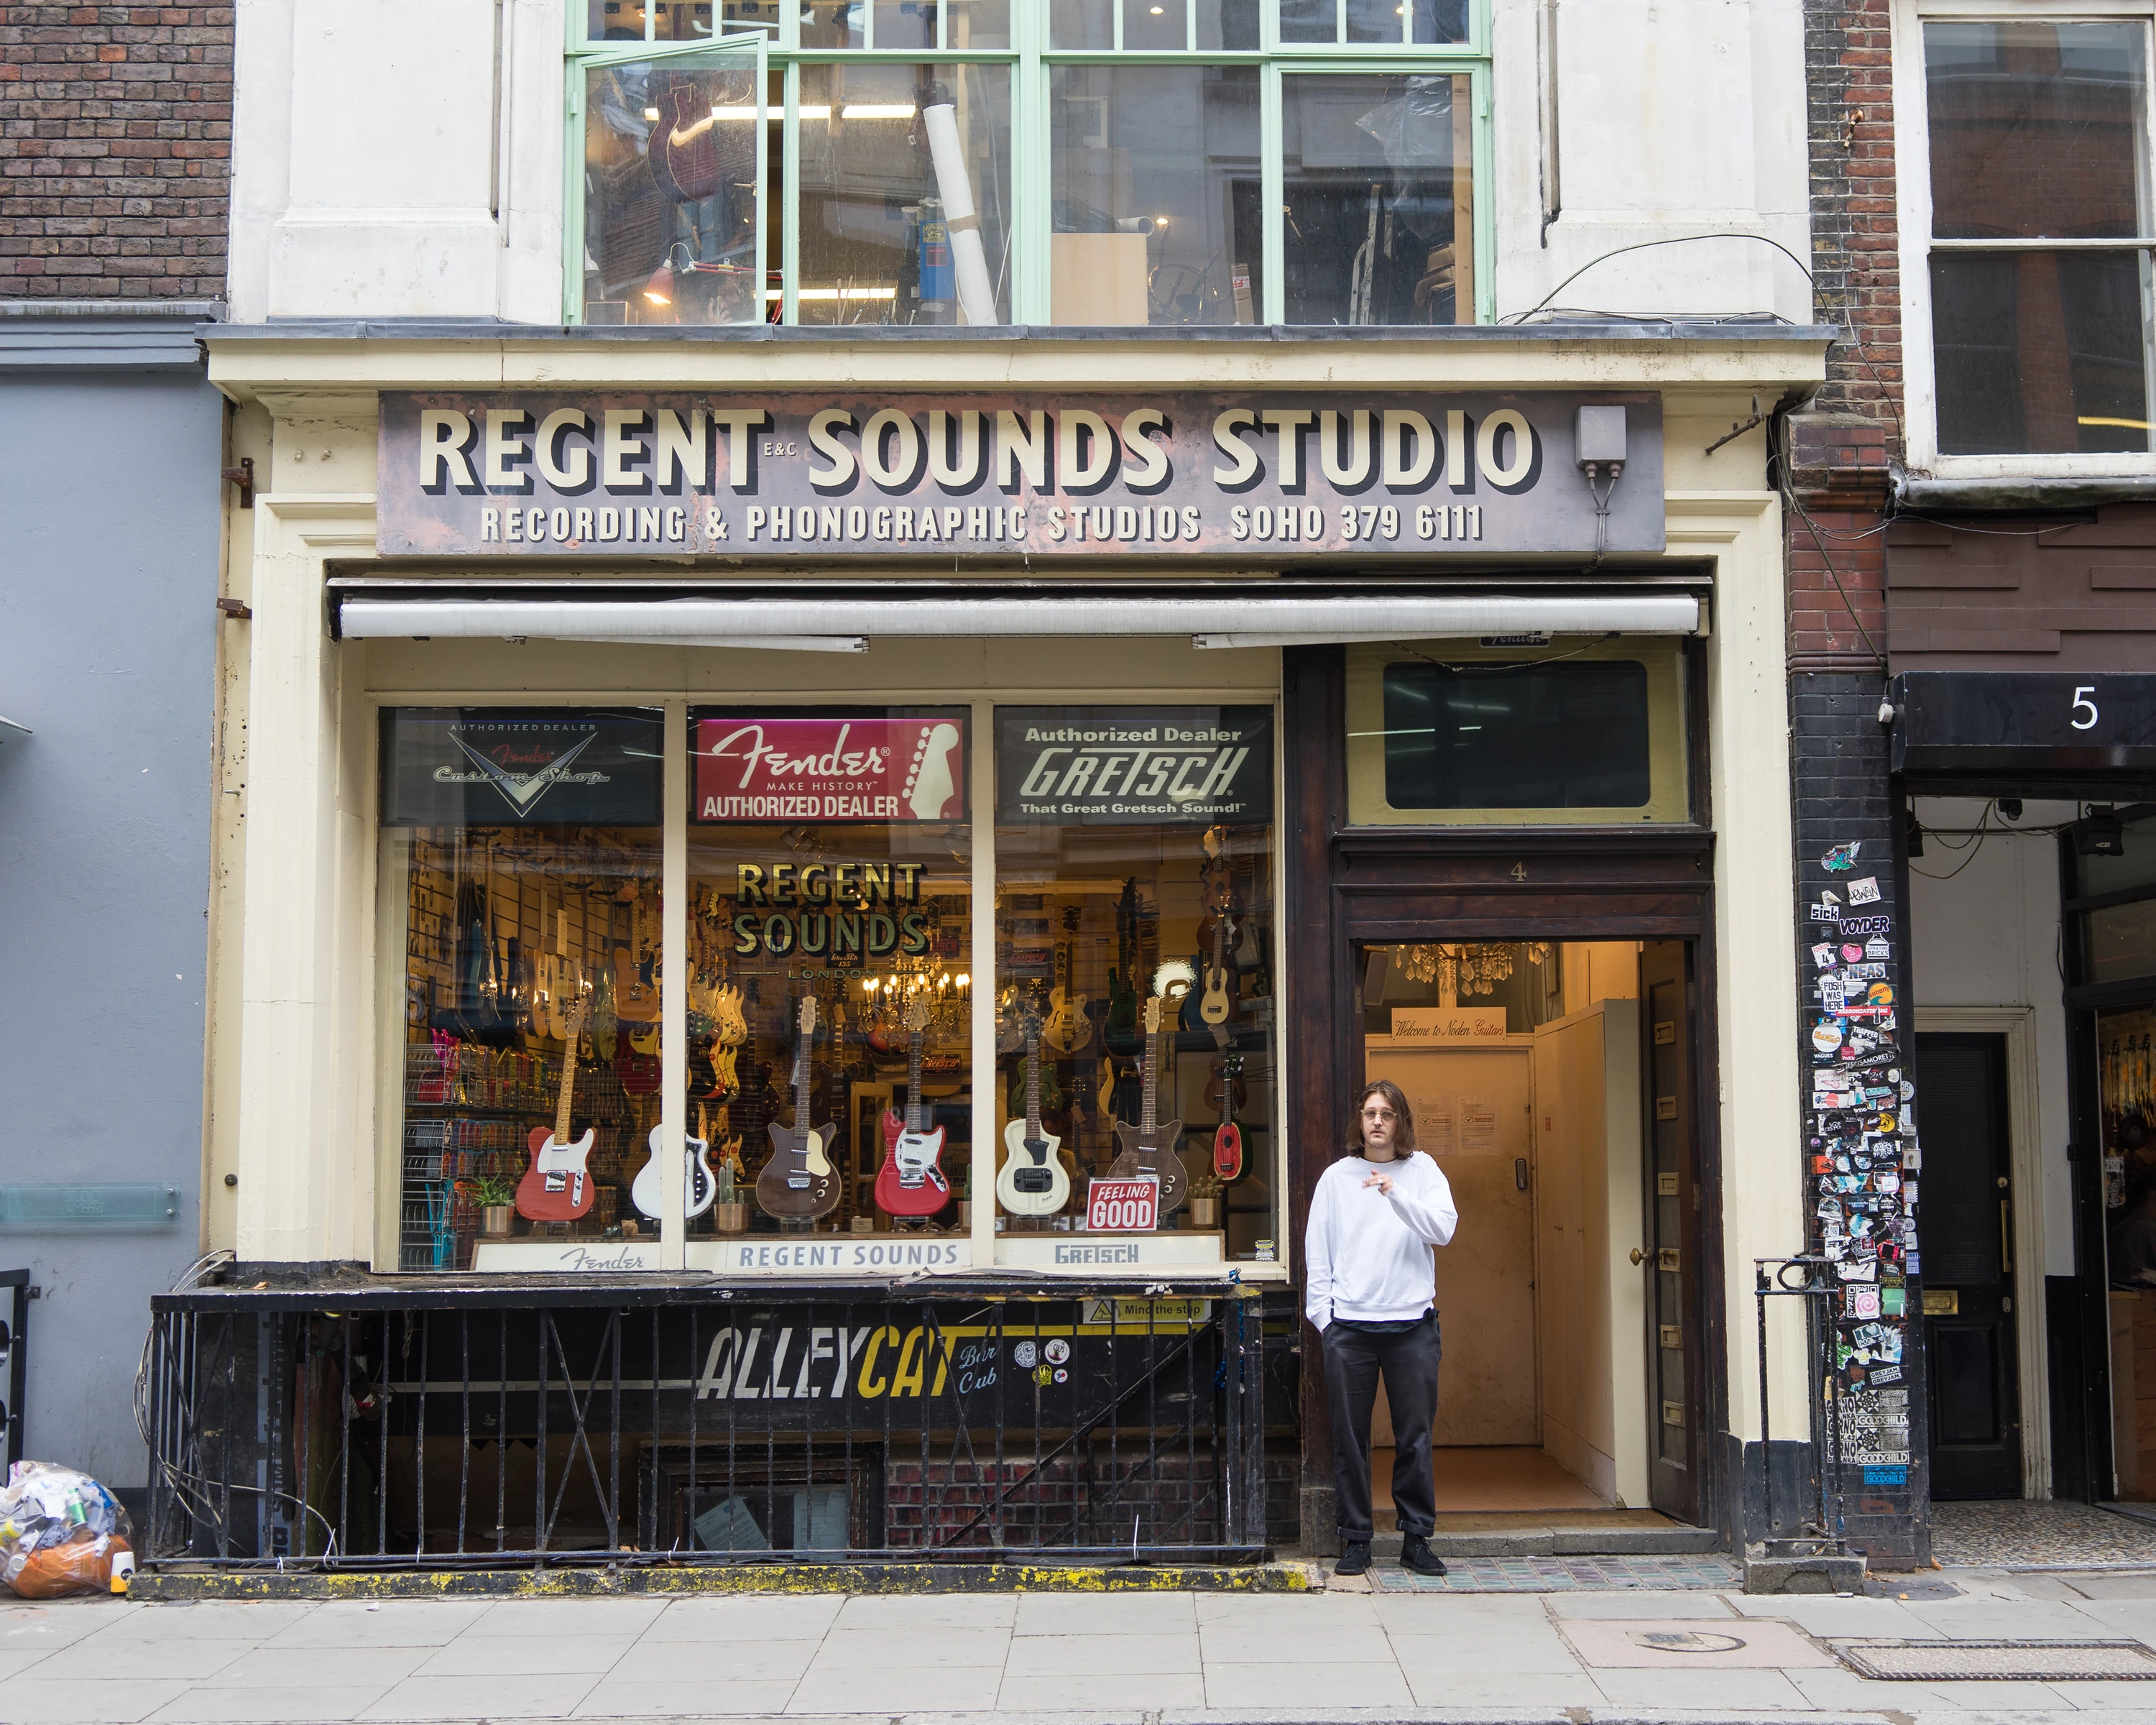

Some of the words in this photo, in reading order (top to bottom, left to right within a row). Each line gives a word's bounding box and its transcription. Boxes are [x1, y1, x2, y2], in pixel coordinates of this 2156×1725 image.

[420, 408, 773, 496] REGENT
[763, 442, 797, 456] E&C
[808, 408, 1171, 497] SOUNDS
[1213, 408, 1542, 496] STUDIO
[481, 506, 687, 543] RECORDING
[704, 507, 729, 540] &
[747, 505, 1028, 542] PHONOGRAPHIC
[1049, 505, 1200, 541] STUDIOS
[1230, 505, 1323, 541] SOHO
[1340, 505, 1399, 541] 379
[1415, 505, 1483, 541] 6111
[2070, 686, 2099, 730] 5
[1025, 727, 1158, 742] Authorized
[1164, 727, 1242, 742] Dealer
[491, 743, 552, 767] Fender
[711, 723, 885, 789] Fender
[433, 765, 534, 783] Custom
[539, 766, 610, 785] Shop
[1020, 748, 1250, 796] GRETSCH
[767, 782, 803, 791] MAKE
[813, 782, 872, 791] HISTORY
[704, 796, 819, 816] AUTHORIZED
[824, 796, 898, 816] DEALER
[1021, 804, 1057, 814] That
[1061, 804, 1107, 814] Great
[1111, 804, 1177, 814] Gretsch
[1181, 804, 1240, 814] Sound!
[1511, 862, 1526, 882] 4
[737, 862, 928, 907] REGENT
[1840, 916, 1889, 934] VOYDER
[734, 913, 931, 957] SOUNDS
[788, 969, 877, 980] LONDON
[1826, 991, 1841, 1000] WAS
[1825, 1001, 1843, 1011] HERE
[1395, 1019, 1430, 1036] Welcome
[1432, 1025, 1441, 1036] to
[1442, 1019, 1470, 1036] Noden
[1474, 1018, 1504, 1036] Guitars
[1853, 1026, 1878, 1039] TRAPPED
[63, 1190, 102, 1202] STUDIO
[1097, 1184, 1150, 1200] FEELING
[60, 1202, 105, 1213] LAMBERT
[1092, 1200, 1151, 1228] GOOD
[560, 1246, 643, 1271] Fender
[740, 1246, 843, 1266] REGENT
[854, 1243, 958, 1266] SOUNDS
[1055, 1243, 1139, 1264] GRETSCH
[1156, 1304, 1173, 1315] the
[959, 1367, 997, 1394] Cub
[1871, 1367, 1900, 1378] GREYJAM.
[1872, 1374, 1902, 1385] GREYJAM.
[1858, 1415, 1907, 1425] GOODCHILD
[1859, 1453, 1907, 1463] GOODCHILD
[1866, 1474, 1905, 1483] GOODCHILD
